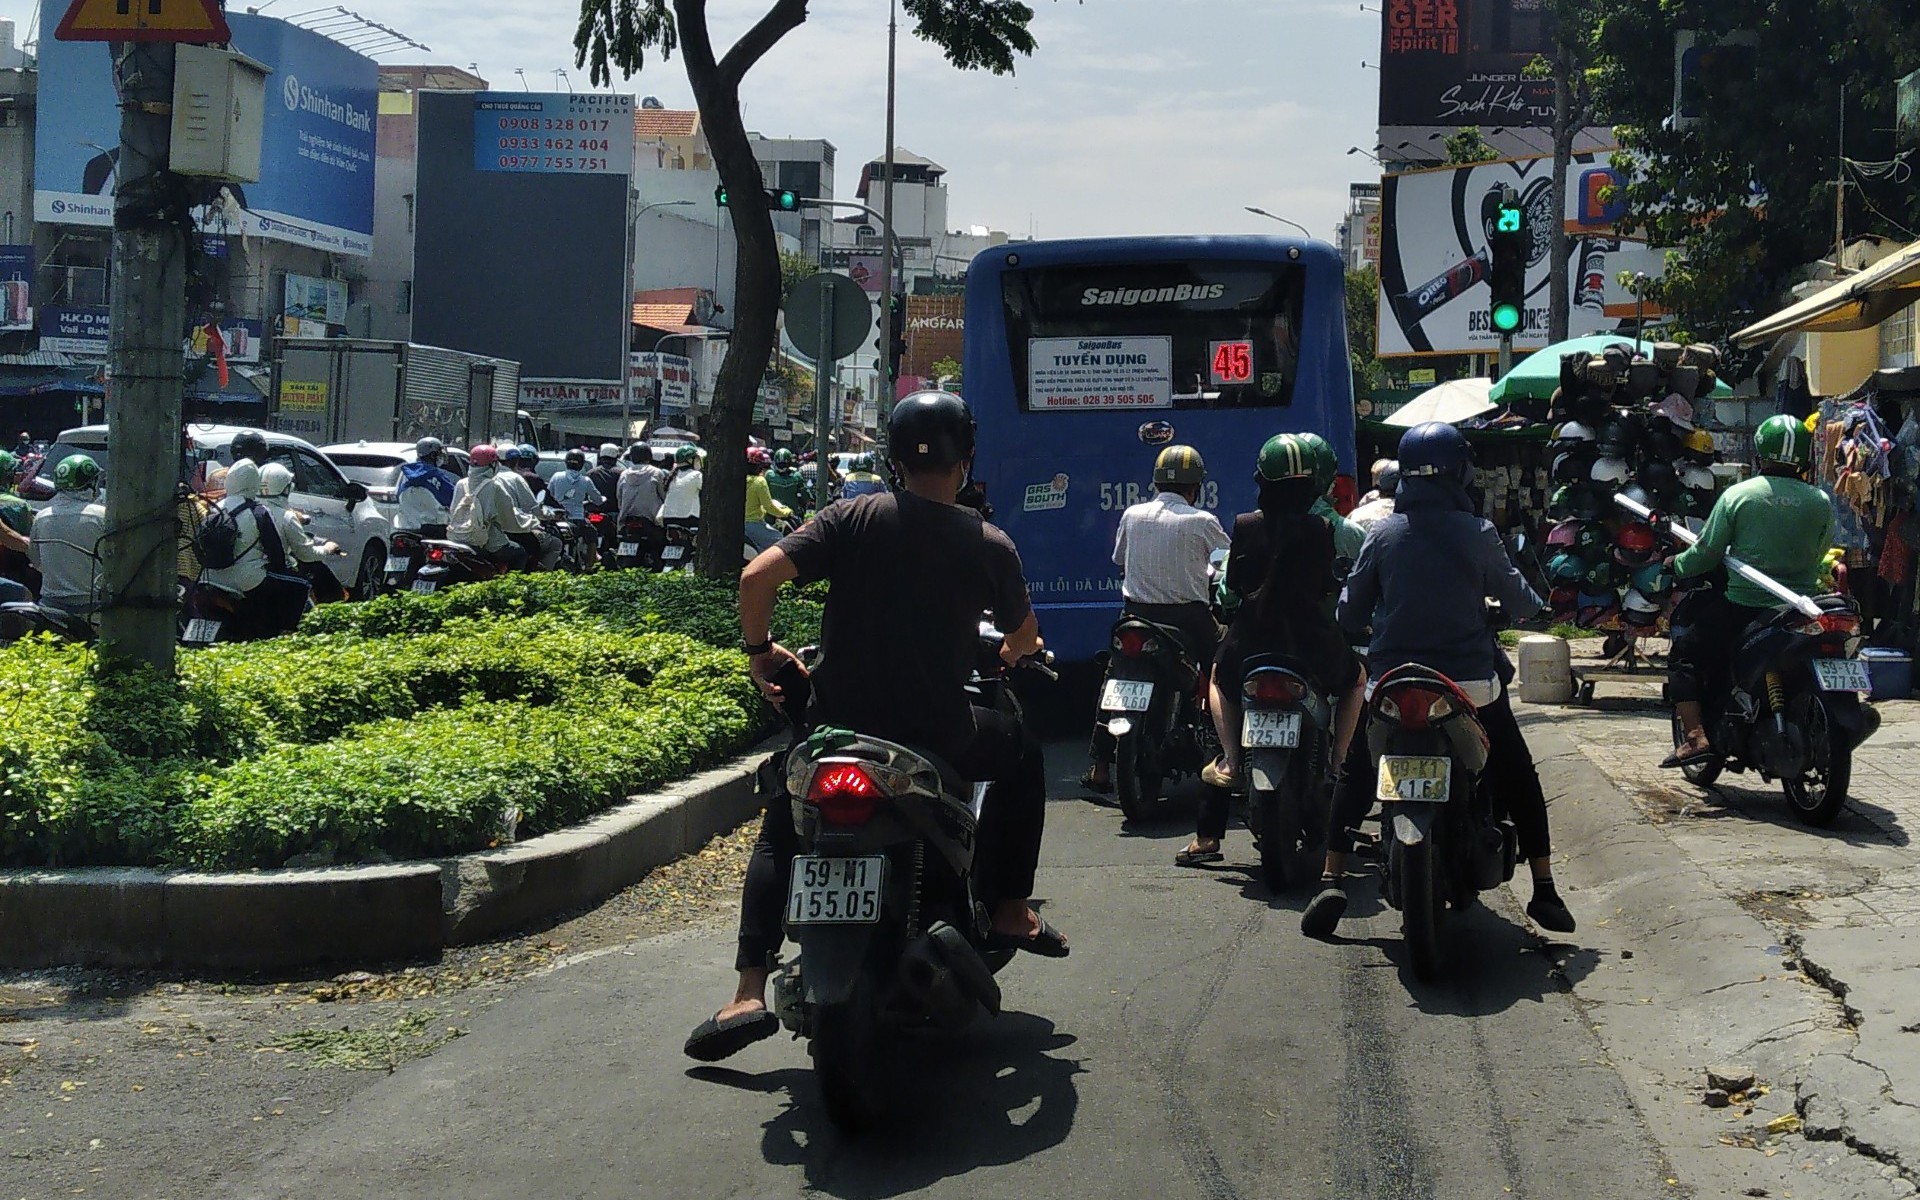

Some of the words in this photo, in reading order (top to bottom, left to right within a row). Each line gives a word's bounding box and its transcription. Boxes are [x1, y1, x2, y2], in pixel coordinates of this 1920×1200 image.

[570, 95, 629, 105] PACIFIC
[300, 86, 344, 123] Shinhan
[346, 102, 371, 132] Bank
[500, 119, 539, 130] 0908
[545, 119, 574, 130] 328
[579, 120, 609, 131] 017
[500, 138, 539, 149] 0933
[544, 138, 574, 150] 462
[579, 139, 609, 151] 404
[500, 156, 539, 167] 0977
[544, 157, 574, 169] 755
[578, 158, 607, 170] 751
[67, 203, 110, 216] Shinhan
[1081, 284, 1225, 306] SaigonBus
[1419, 278, 1447, 304] OREO
[1469, 310, 1492, 331] BES
[1078, 341, 1123, 350] SaigonBus
[1053, 351, 1100, 366] TUYỂN
[1106, 354, 1147, 367] DỤNG
[1214, 343, 1250, 381] 45
[1047, 396, 1080, 406] Hotline:
[1083, 395, 1100, 404] 028
[1103, 395, 1114, 404] 39
[1118, 395, 1135, 404] 505
[1137, 394, 1154, 403] 505
[1028, 485, 1051, 494] GAS
[1026, 493, 1065, 503] SOUTH
[1113, 682, 1145, 696] 67-K1
[1253, 713, 1291, 729] 37-P1
[795, 891, 875, 918] 155.05
